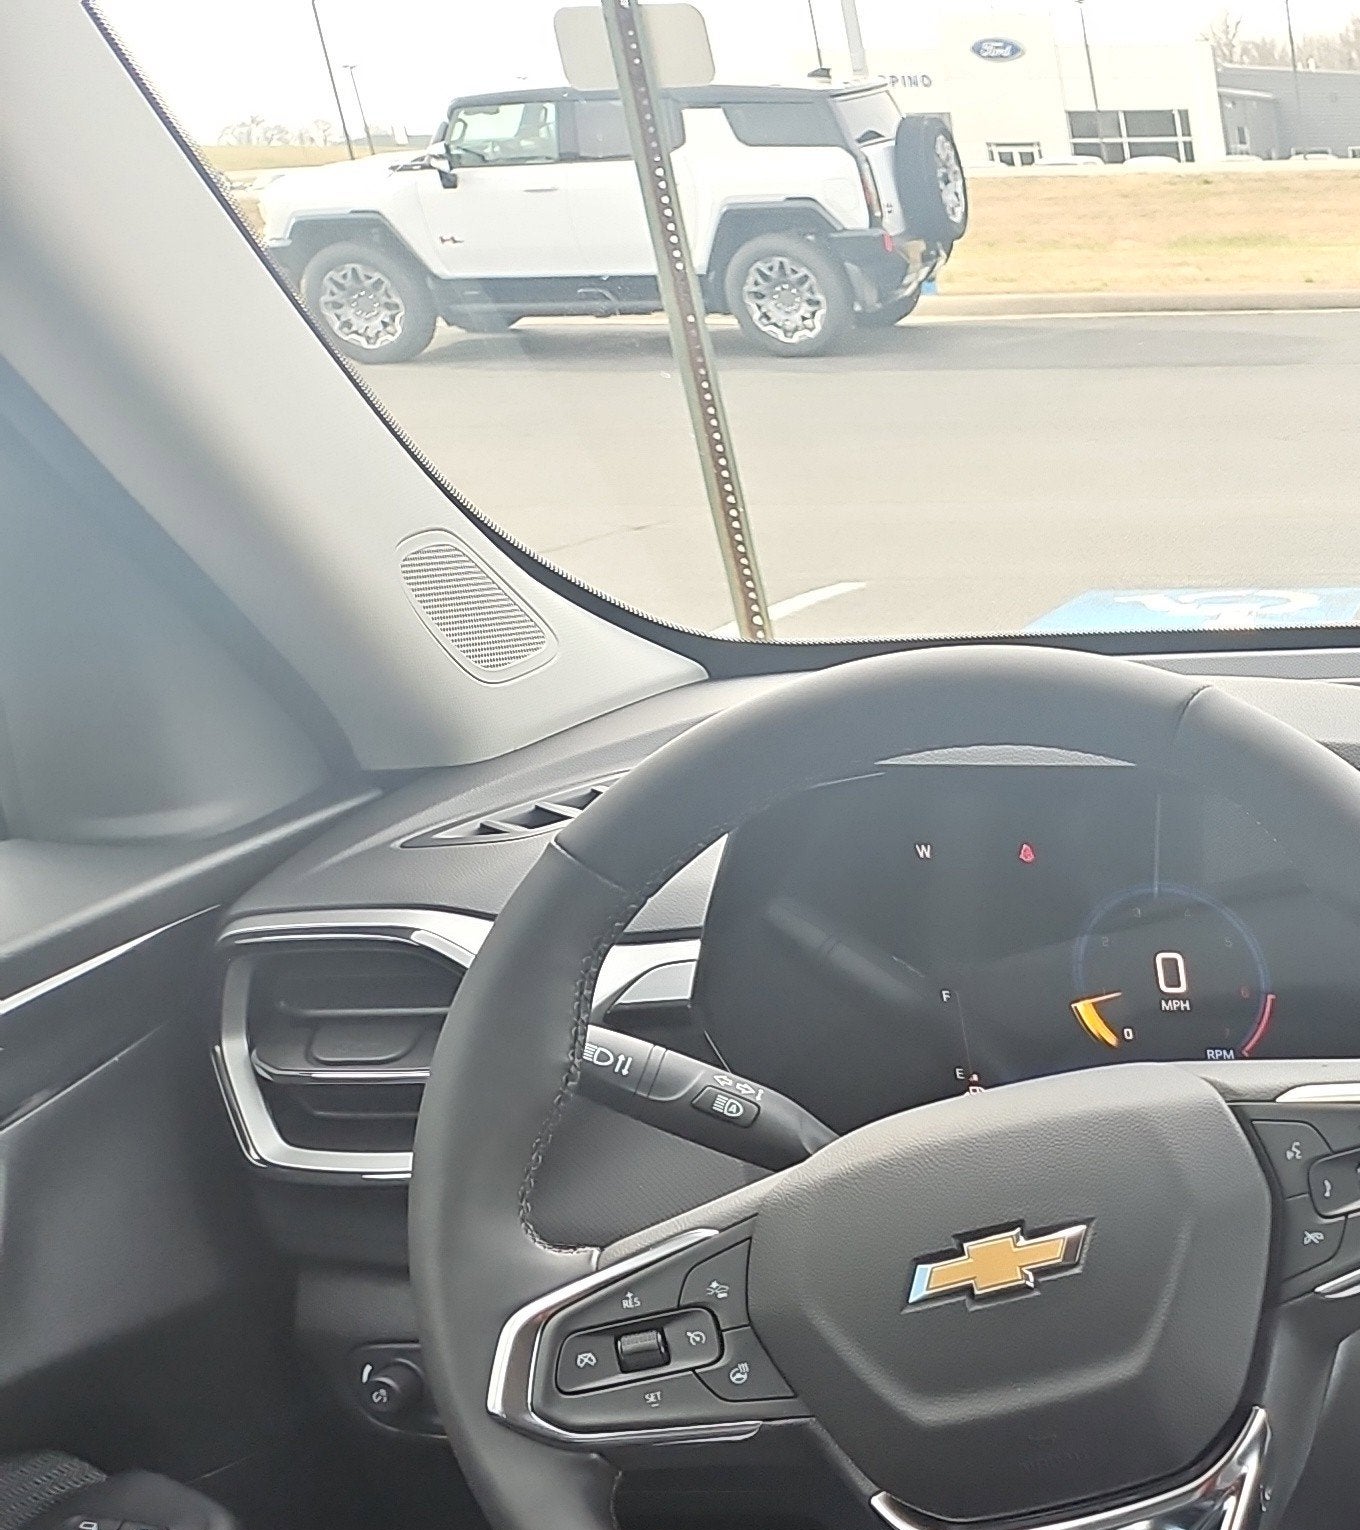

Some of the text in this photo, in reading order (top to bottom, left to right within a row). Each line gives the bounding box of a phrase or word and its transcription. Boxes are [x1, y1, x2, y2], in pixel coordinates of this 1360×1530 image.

[878, 75, 932, 88] PINO
[915, 843, 932, 859] W
[1155, 951, 1187, 994] 0
[941, 990, 951, 1002] F
[1161, 1000, 1191, 1012] MPH
[1123, 1028, 1133, 1040] 0
[1206, 1049, 1235, 1060] RPM
[955, 1067, 965, 1079] E
